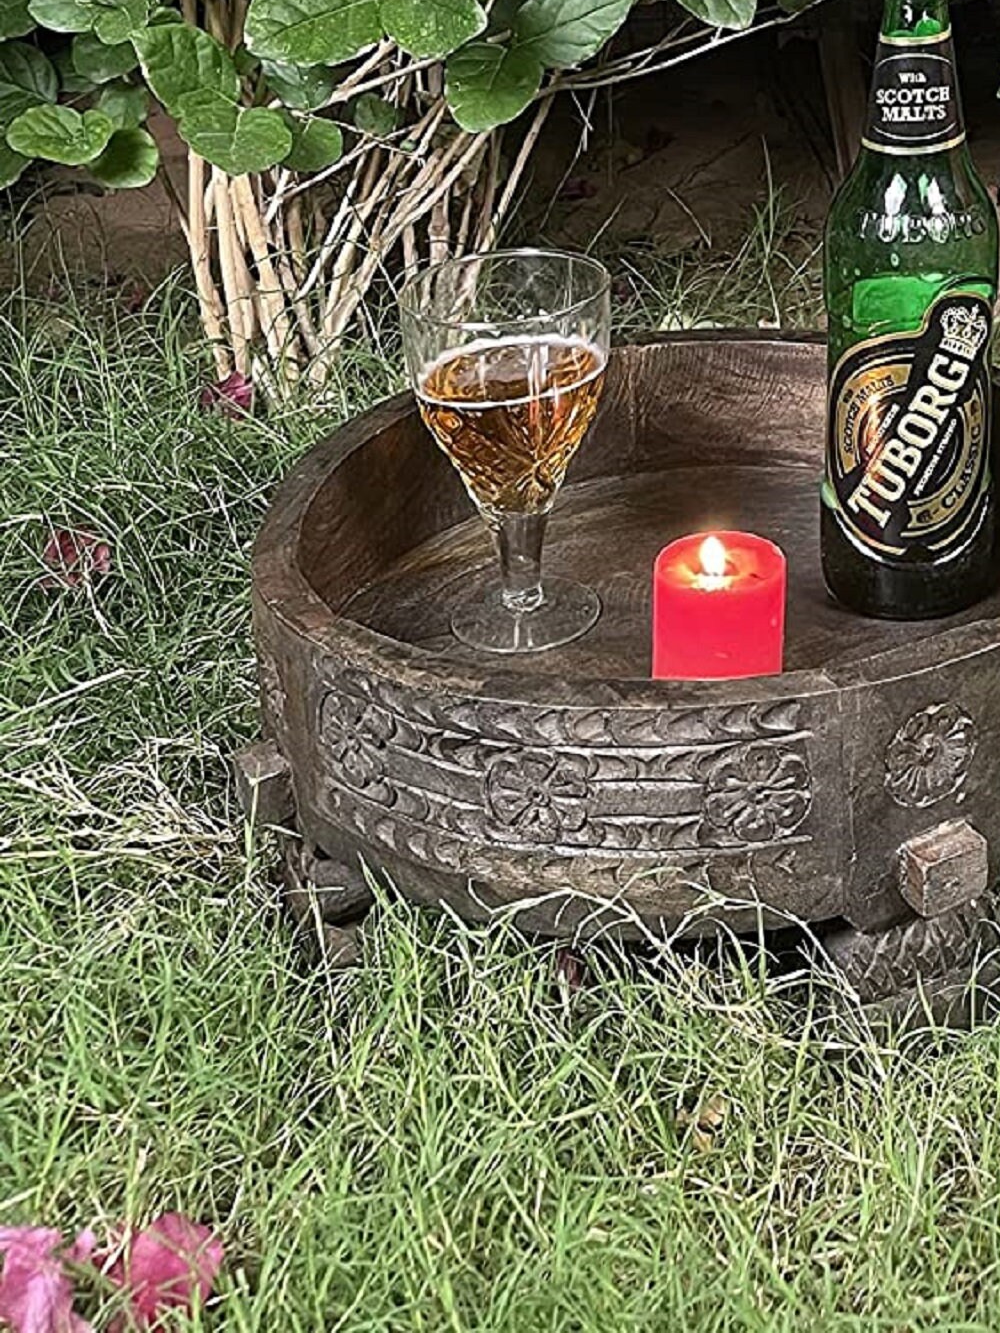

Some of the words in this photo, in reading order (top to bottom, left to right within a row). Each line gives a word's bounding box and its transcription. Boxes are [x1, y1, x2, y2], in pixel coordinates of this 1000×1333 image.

[875, 86, 950, 105] SCOTCH
[898, 72, 927, 84] With
[881, 104, 947, 122] MALTS
[843, 400, 860, 455] SCOTCH
[856, 374, 895, 404] MALTS
[847, 352, 972, 529] TUBORG
[941, 422, 980, 509] CLASSIC
